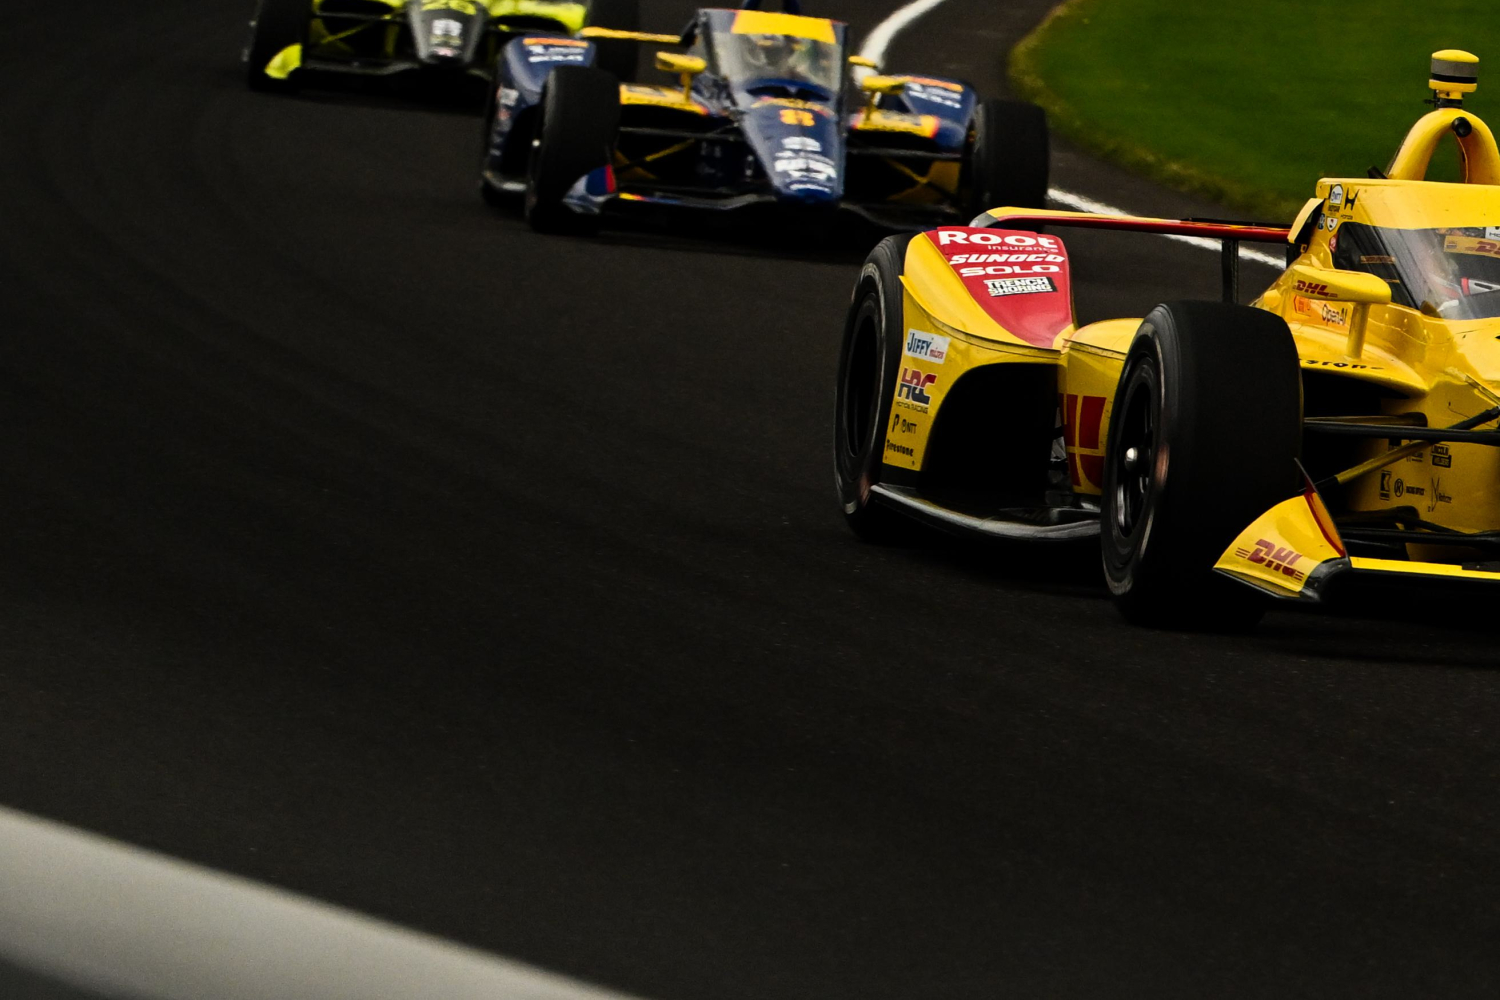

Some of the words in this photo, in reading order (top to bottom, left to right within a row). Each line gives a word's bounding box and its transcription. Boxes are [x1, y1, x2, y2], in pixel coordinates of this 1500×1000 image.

[950, 253, 1065, 265] SUNOCO
[960, 264, 1060, 277] SOLO
[984, 277, 1048, 288] TRENCH
[1295, 280, 1330, 297] DHL
[988, 286, 1053, 296] SHORING
[907, 332, 933, 356] JIFFY
[897, 367, 937, 406] HRC
[886, 439, 914, 457] Firestone
